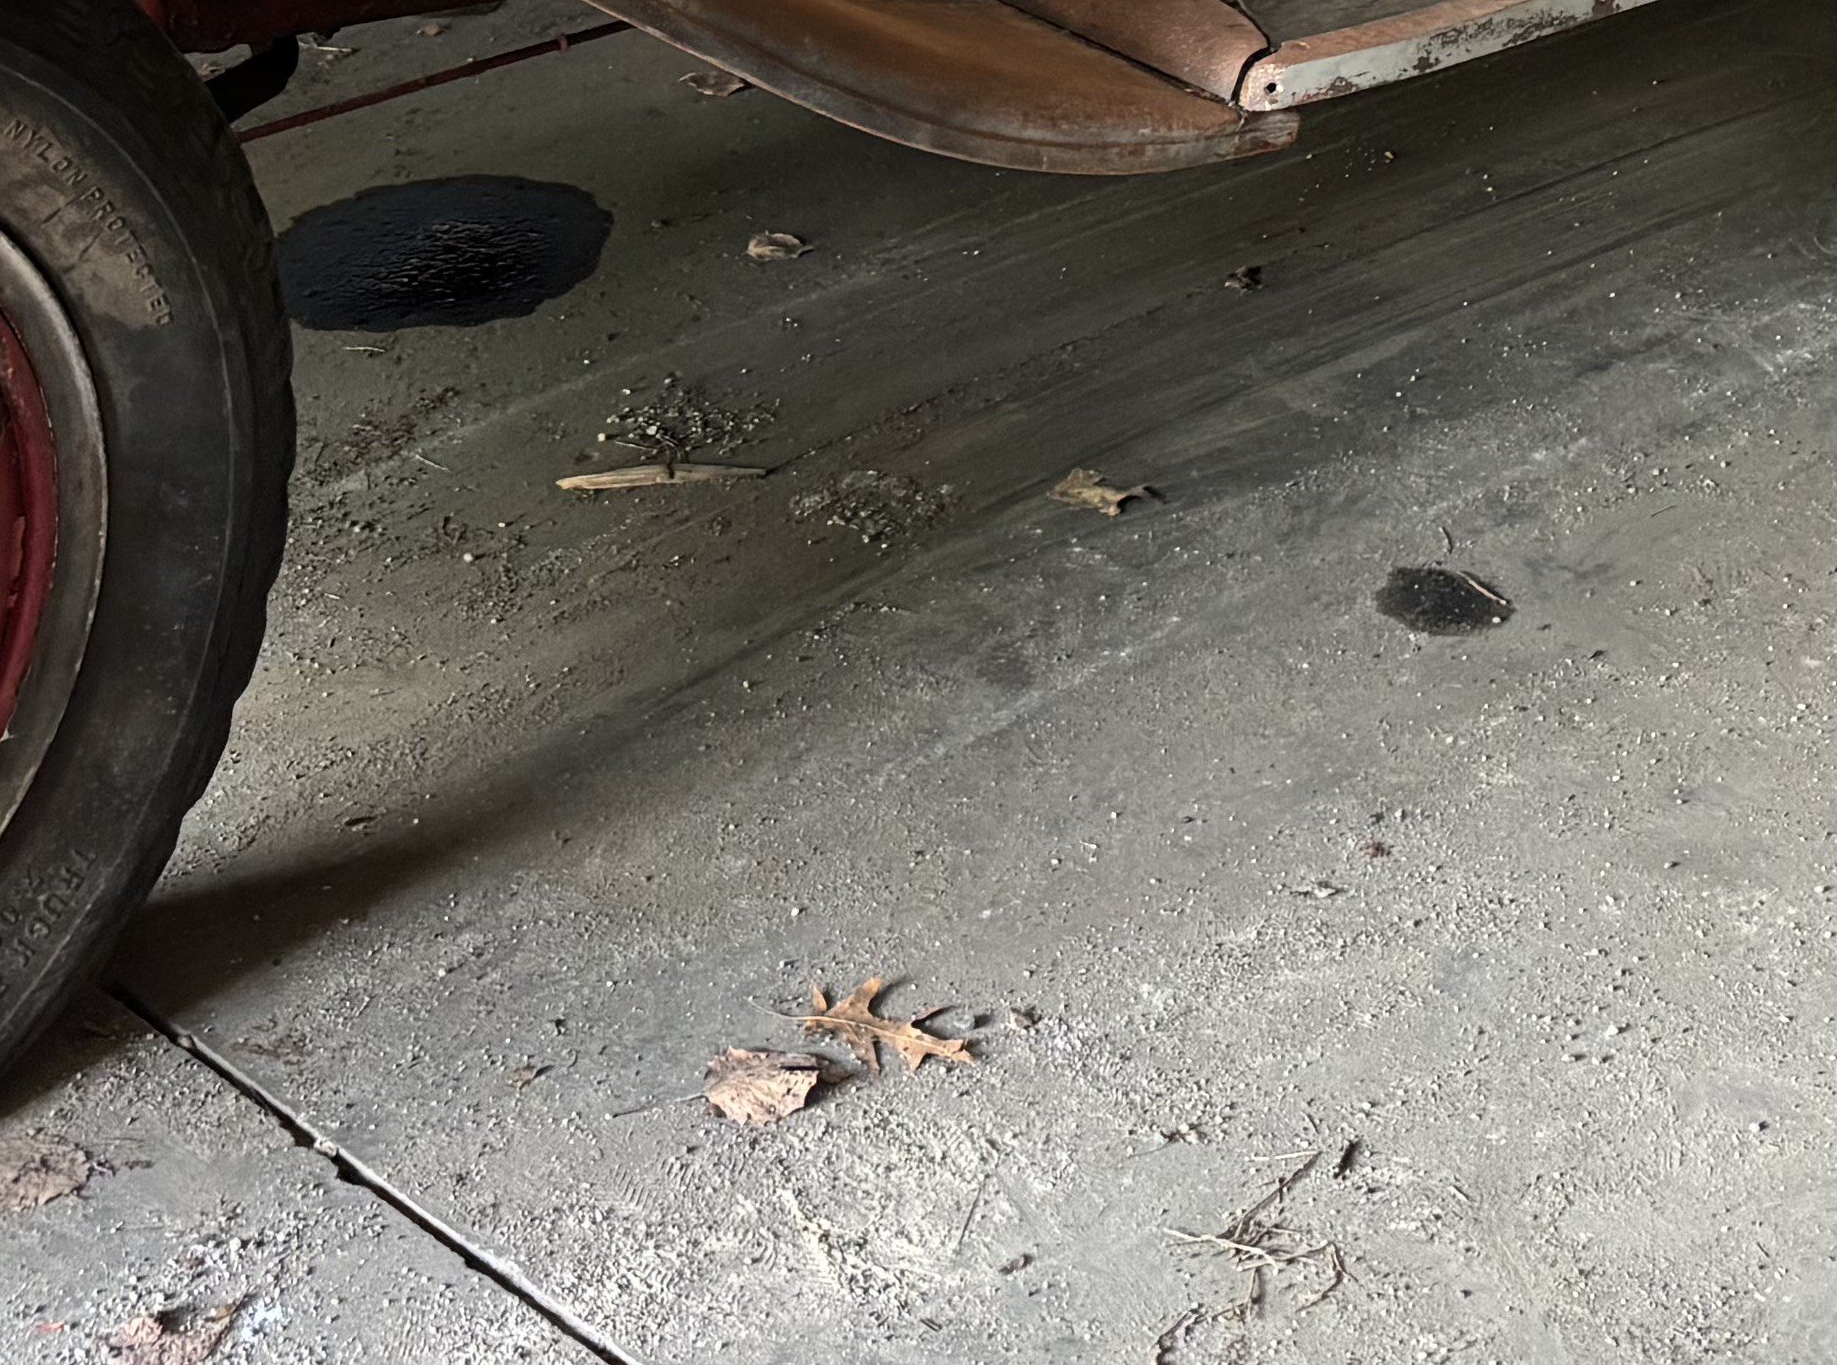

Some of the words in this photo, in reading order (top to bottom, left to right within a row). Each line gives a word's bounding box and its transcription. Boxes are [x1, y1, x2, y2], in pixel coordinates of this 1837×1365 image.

[3, 119, 88, 187] NYLON
[79, 185, 176, 327] PROTECTED
[15, 848, 97, 968] TRUCK
